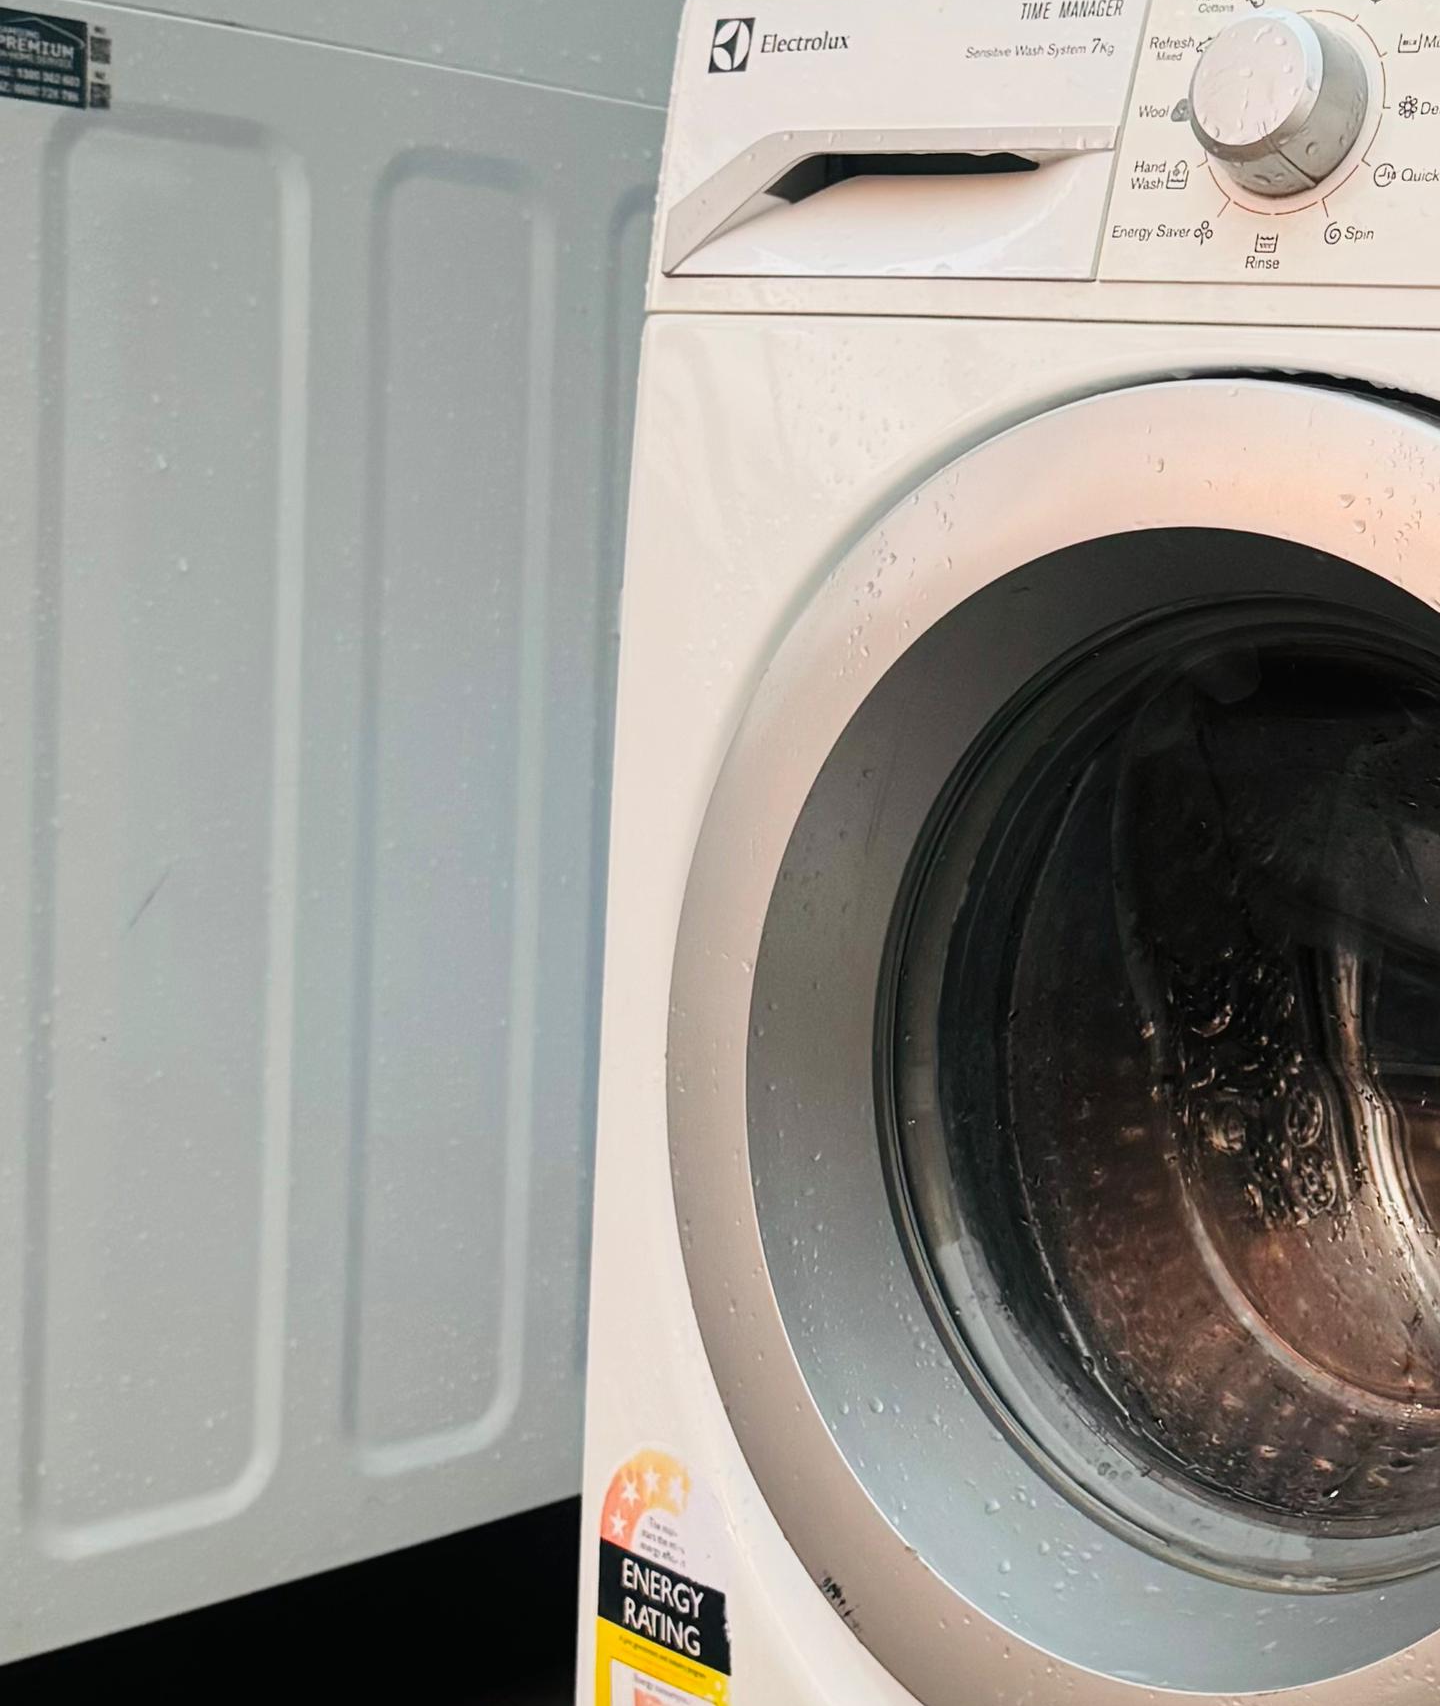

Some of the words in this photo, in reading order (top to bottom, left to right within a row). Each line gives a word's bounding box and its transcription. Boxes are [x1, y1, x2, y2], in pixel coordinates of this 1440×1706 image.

[1020, 1, 1052, 21] TIME
[759, 30, 852, 54] Electrolux
[1014, 42, 1046, 58] Wash
[1047, 41, 1087, 60] System
[1149, 36, 1195, 51] Refresh
[1139, 104, 1169, 119] Wool
[1134, 160, 1166, 175] Hand
[1401, 167, 1440, 182] Quick
[1131, 176, 1164, 190] Wash
[1111, 224, 1153, 241] Energy
[1156, 224, 1191, 239] Saver
[1344, 226, 1374, 243] Spin
[1244, 255, 1280, 270] Rinse
[621, 1556, 704, 1619] ENERGY
[624, 1597, 701, 1657] RATING
